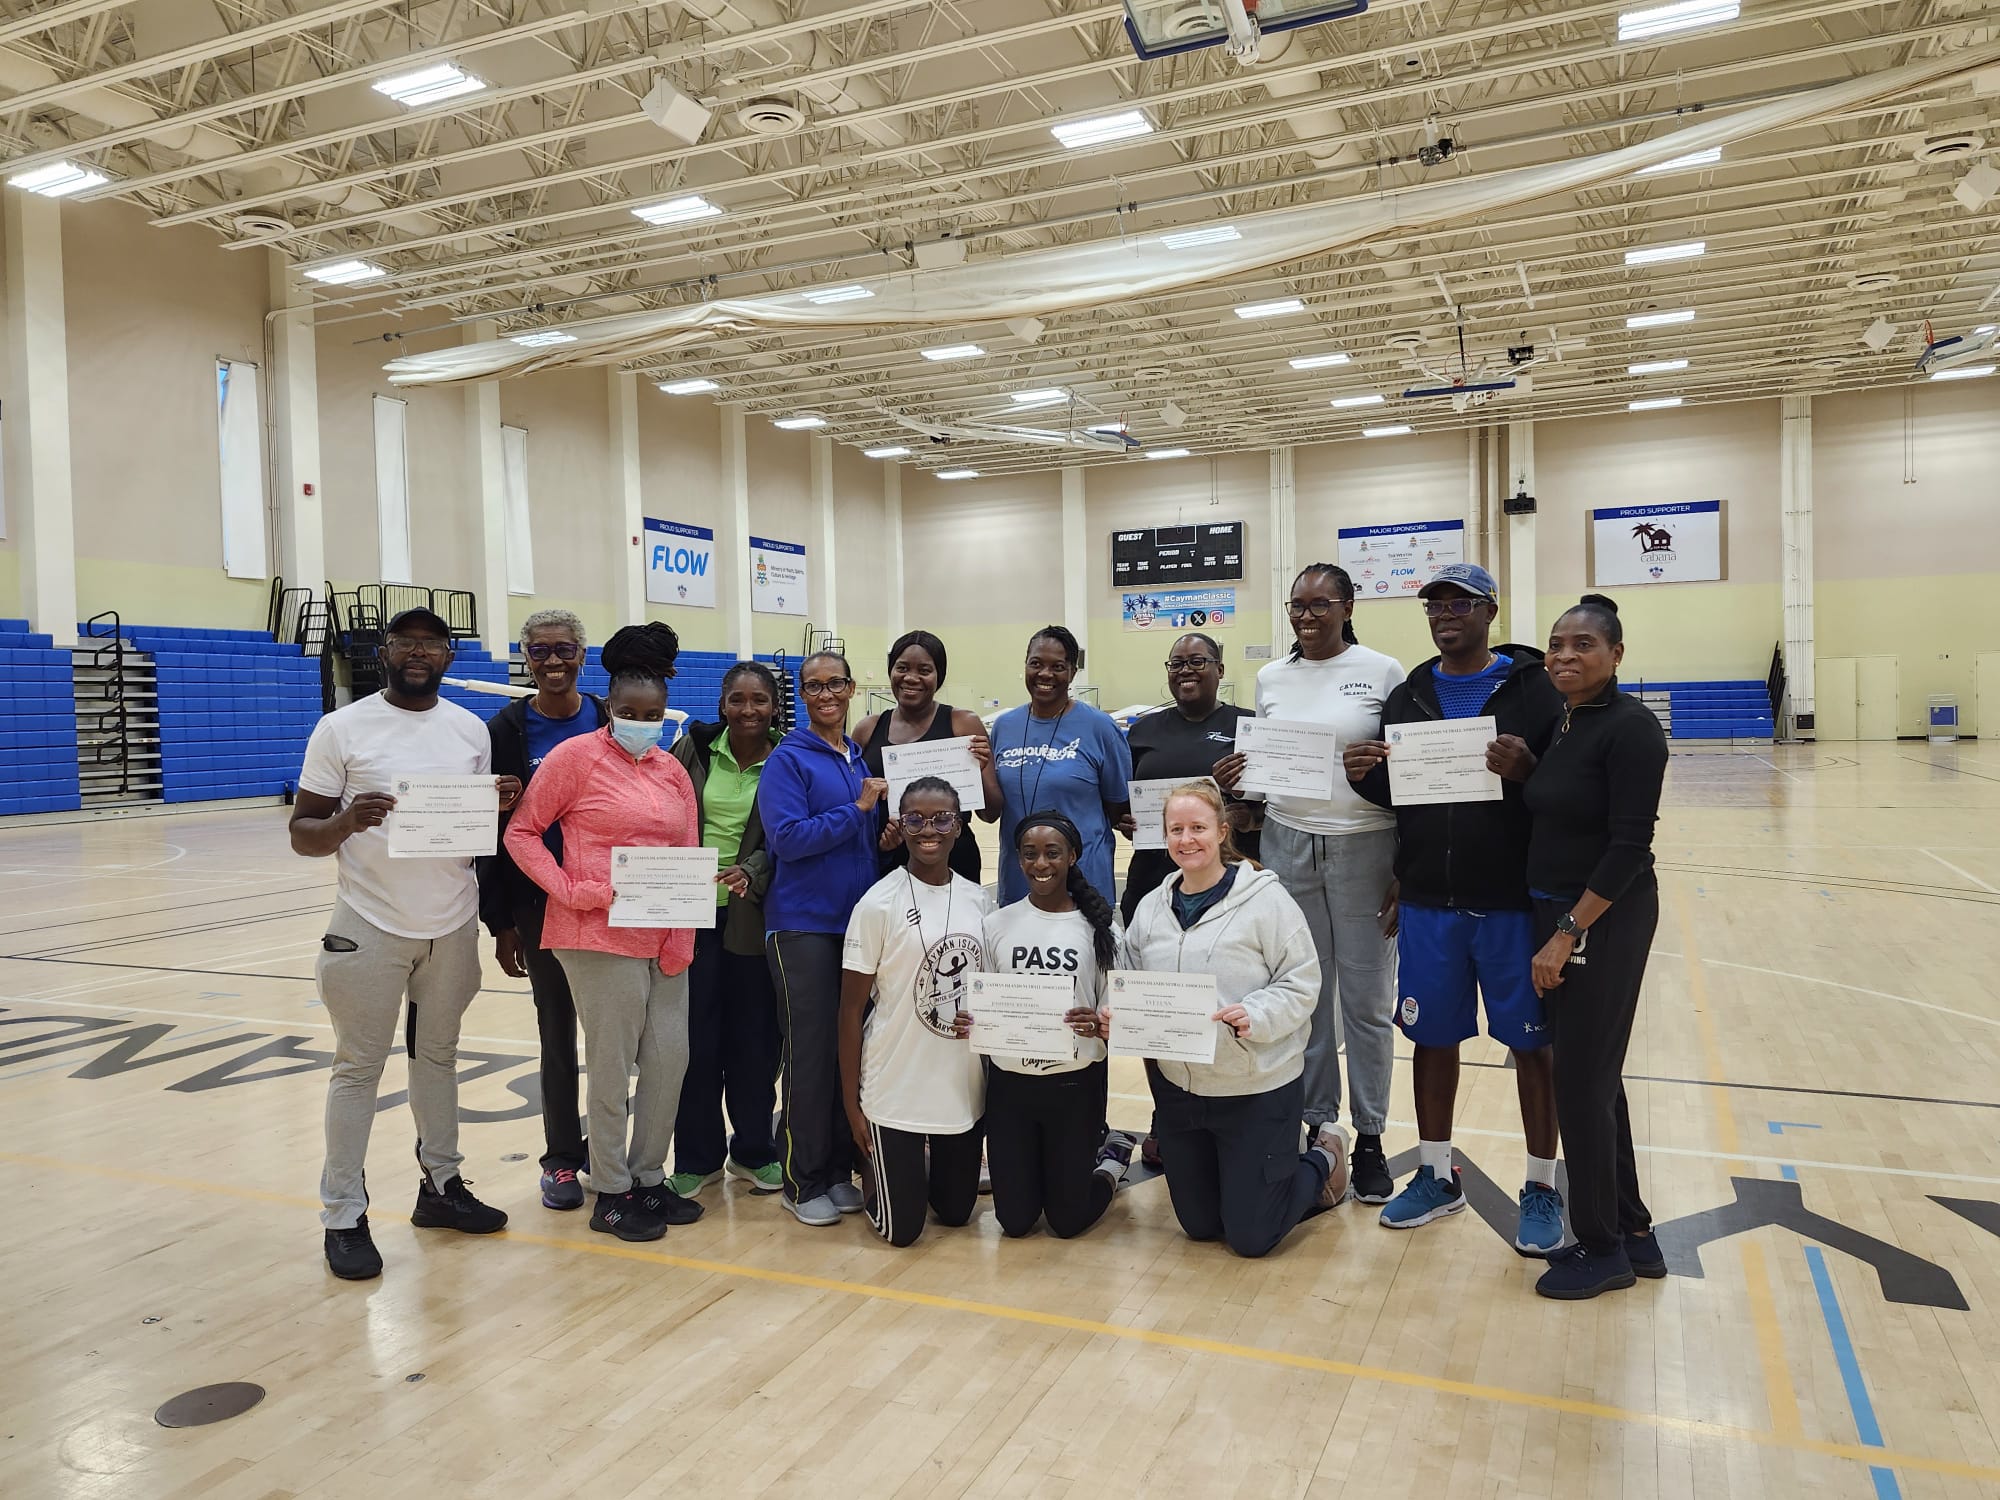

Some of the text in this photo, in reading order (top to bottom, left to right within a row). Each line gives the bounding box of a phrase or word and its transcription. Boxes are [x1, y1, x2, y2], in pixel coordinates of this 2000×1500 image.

[1647, 506, 1690, 514] SUPPORTER
[675, 526, 698, 536] SUPPORTER
[1209, 526, 1234, 534] HOME
[1370, 524, 1428, 535] MAJOR SPONSORS
[1118, 532, 1144, 542] GUEST
[652, 545, 708, 576] FLOW
[1640, 552, 1676, 562] cabana
[1390, 568, 1416, 576] FLOW
[1164, 592, 1231, 602] #CaymanClassic
[1339, 682, 1372, 691] CAYMAN
[1012, 946, 1078, 971] PASS
